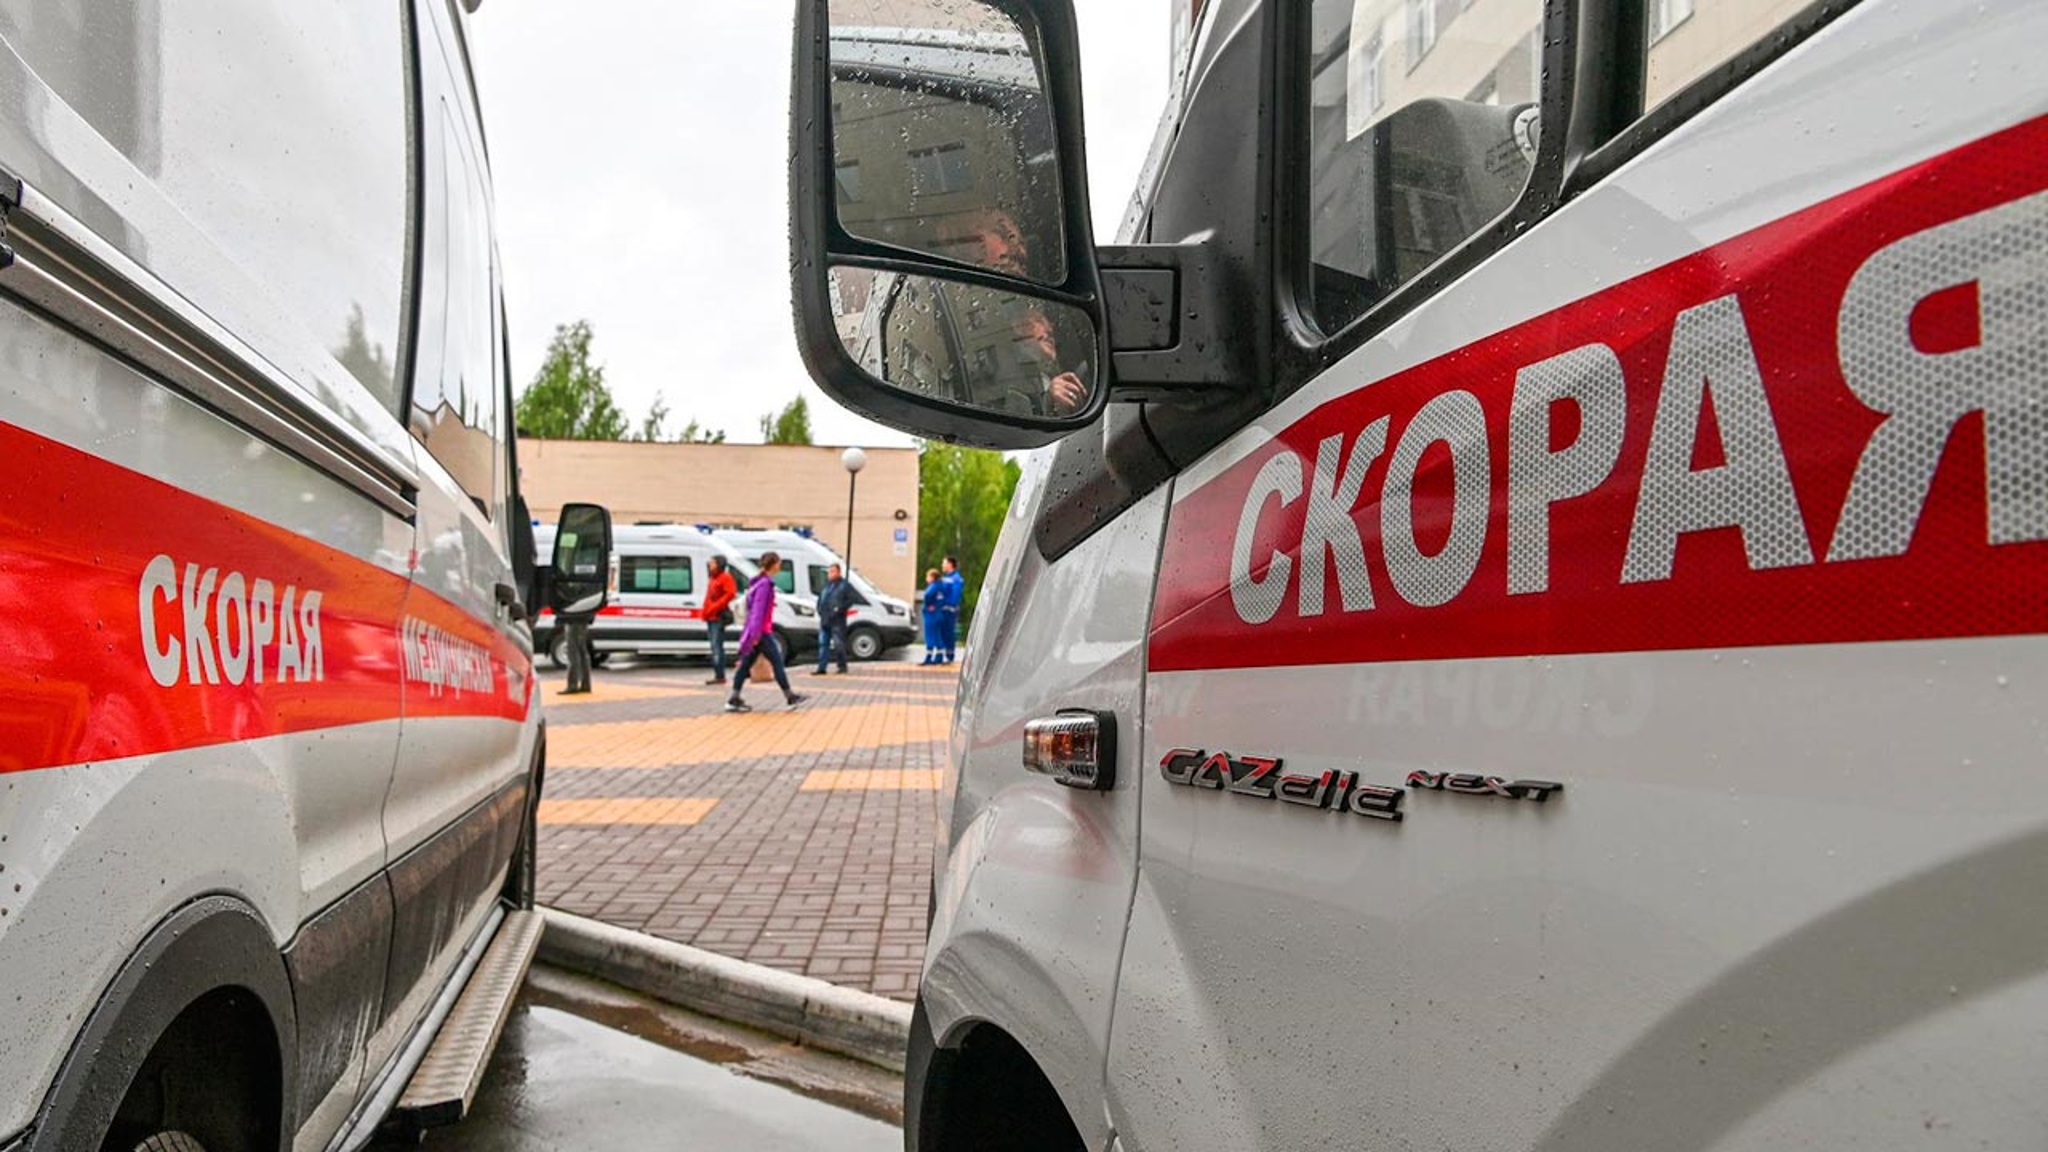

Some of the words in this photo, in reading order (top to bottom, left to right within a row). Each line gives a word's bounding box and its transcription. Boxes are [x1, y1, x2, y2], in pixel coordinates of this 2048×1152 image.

[1230, 190, 2048, 625] СКОРАЯ
[138, 554, 324, 688] СКОРАЯ
[1405, 768, 1564, 804] NEXT
